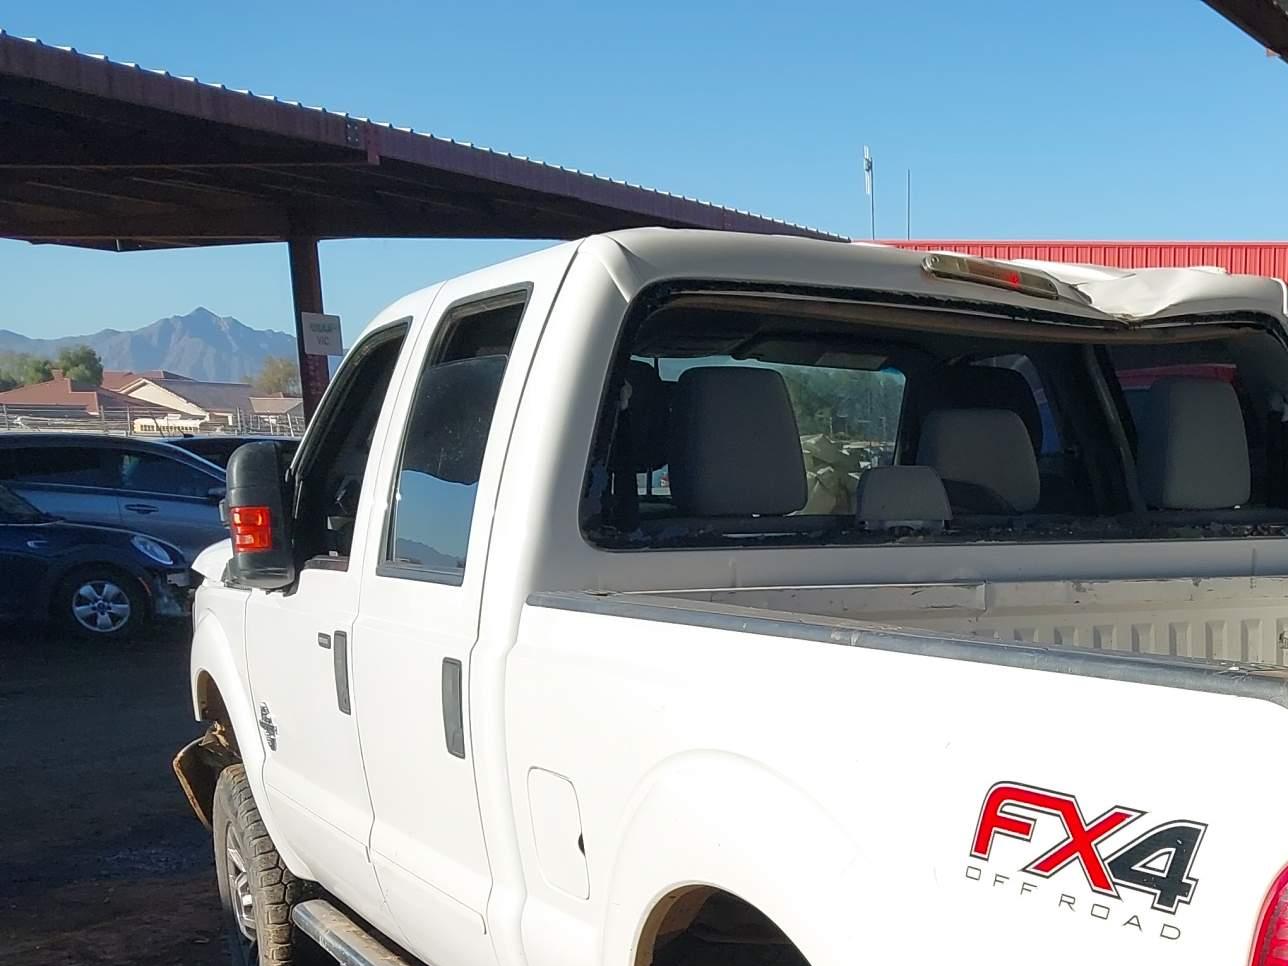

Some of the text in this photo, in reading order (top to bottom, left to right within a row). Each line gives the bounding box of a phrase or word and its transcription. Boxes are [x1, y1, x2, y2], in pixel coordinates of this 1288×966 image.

[969, 780, 1209, 915] FX4
[964, 865, 1182, 941] OFF ROAD
